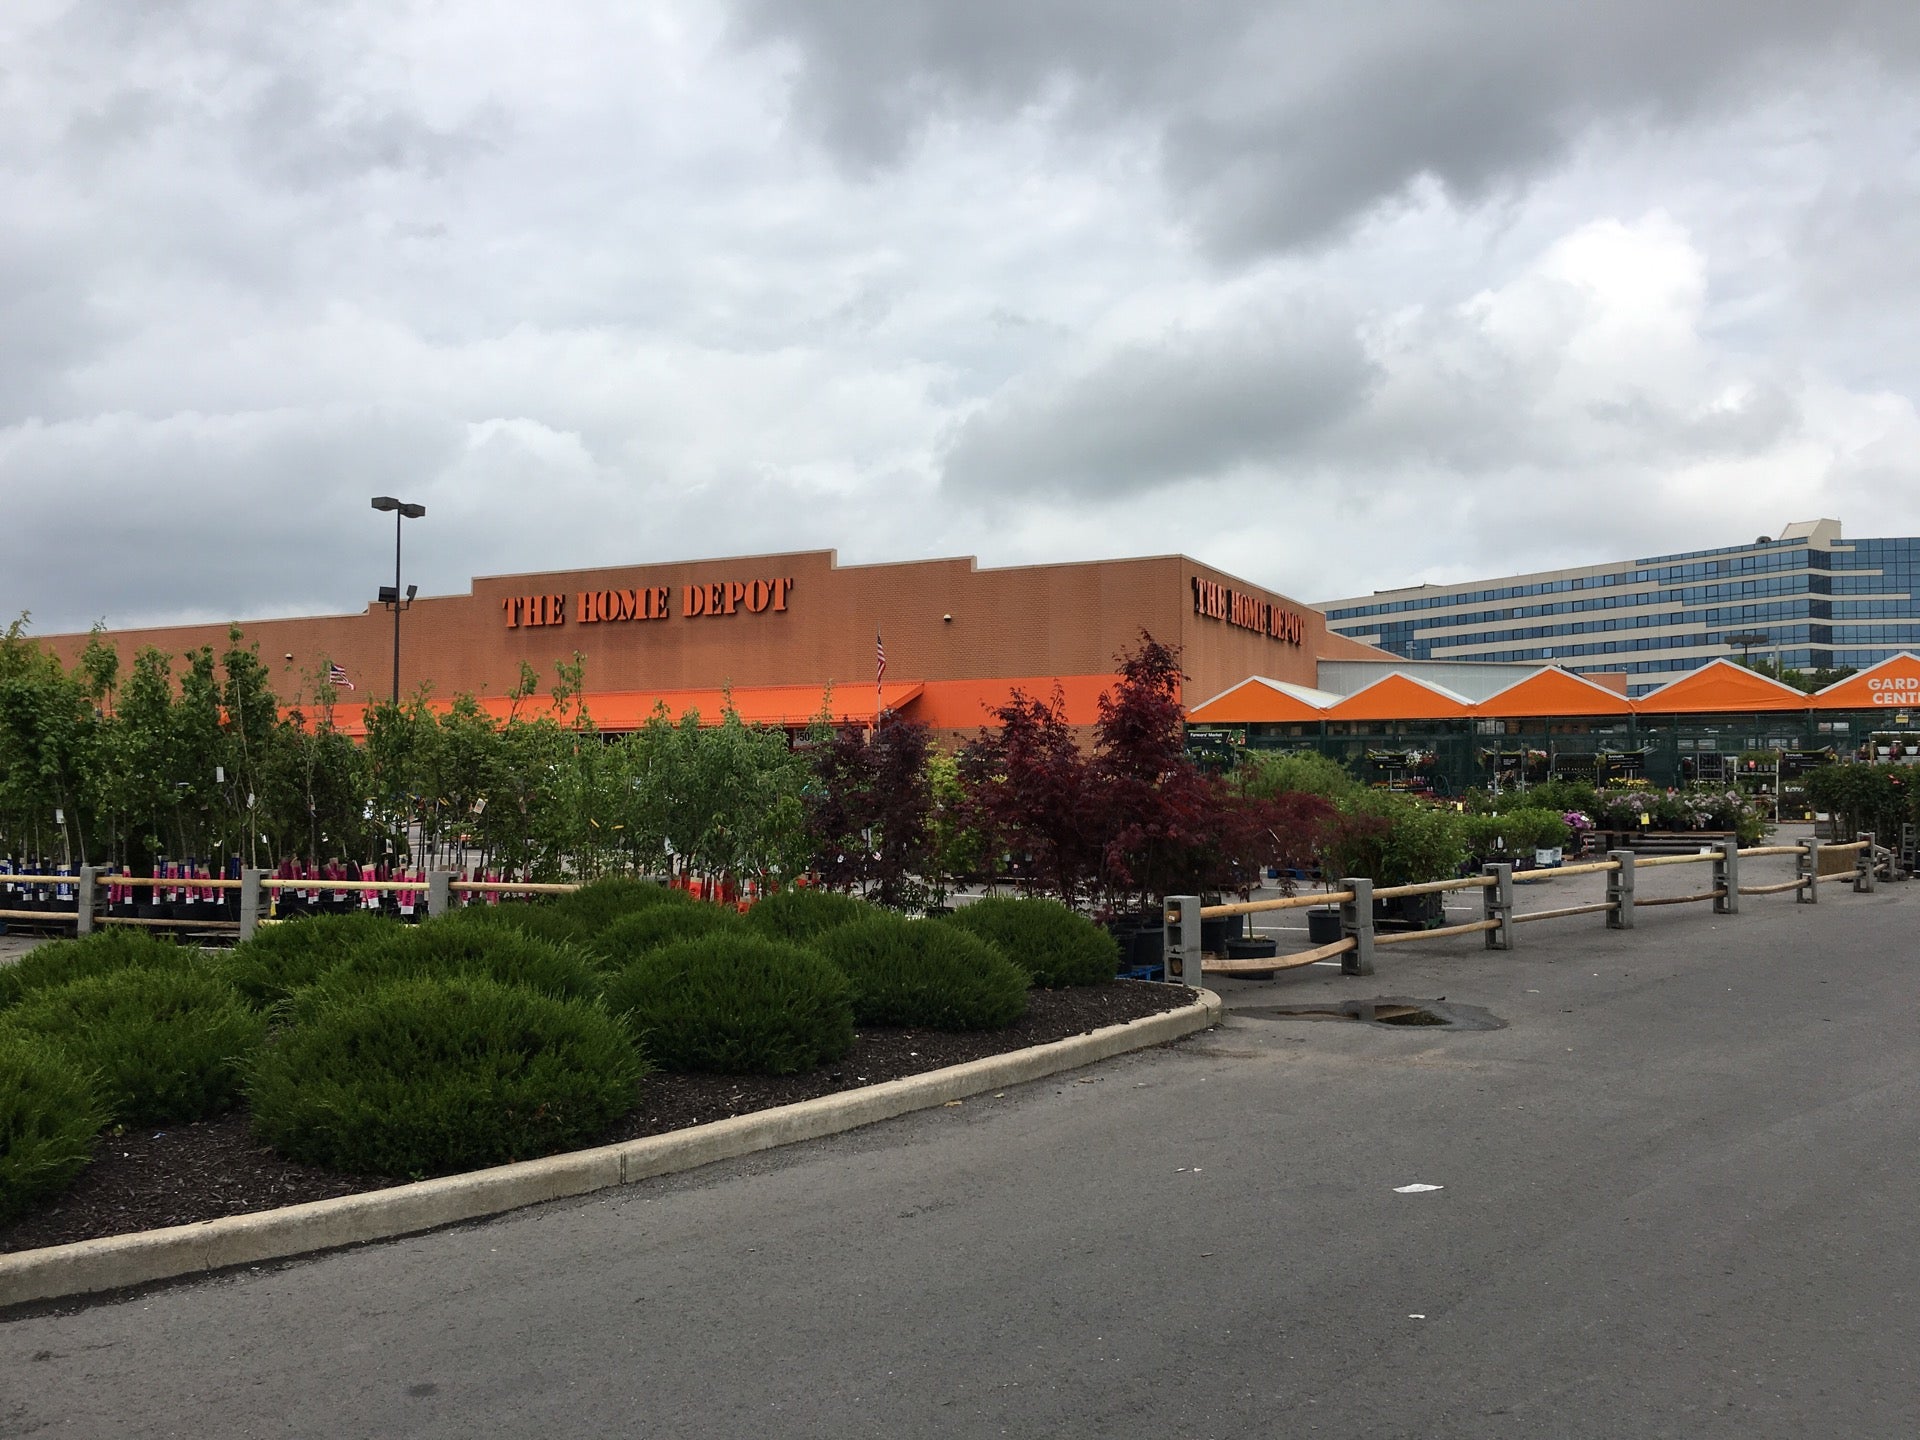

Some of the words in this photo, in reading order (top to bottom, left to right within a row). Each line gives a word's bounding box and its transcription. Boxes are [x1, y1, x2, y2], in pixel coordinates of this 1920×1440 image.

[503, 594, 566, 628] THE
[576, 586, 670, 624] HOME
[682, 577, 793, 617] DEPOT
[1192, 577, 1227, 621] THE
[1227, 590, 1267, 634] HOME
[1267, 605, 1305, 647] DEPOT
[1872, 691, 1920, 705] CENT
